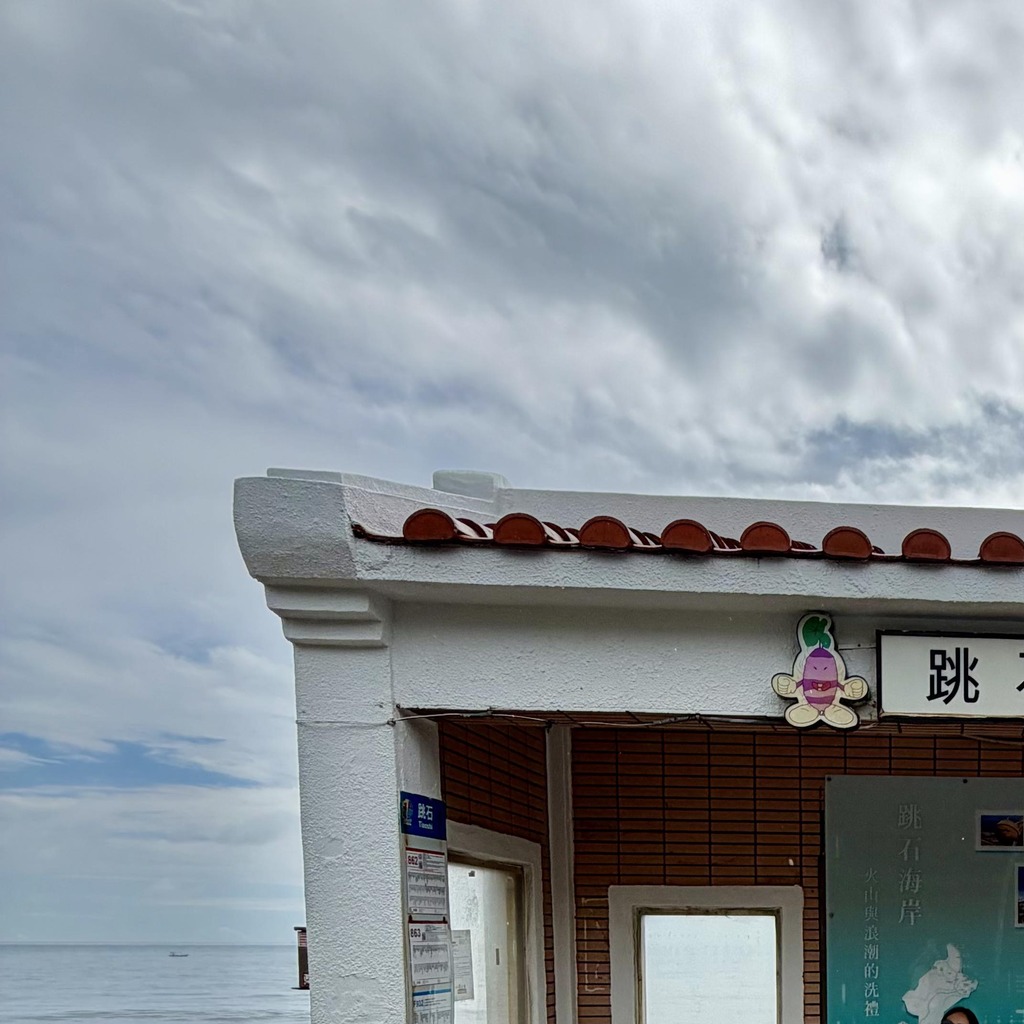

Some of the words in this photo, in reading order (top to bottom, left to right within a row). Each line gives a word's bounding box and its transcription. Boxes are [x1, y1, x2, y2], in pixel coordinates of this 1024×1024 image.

[417, 803, 433, 821] 跳石
[407, 855, 418, 865] 862
[897, 803, 922, 926] 跳石海岸
[410, 928, 421, 938] 863
[863, 868, 881, 1018] 火山與浪潮的洗禮
